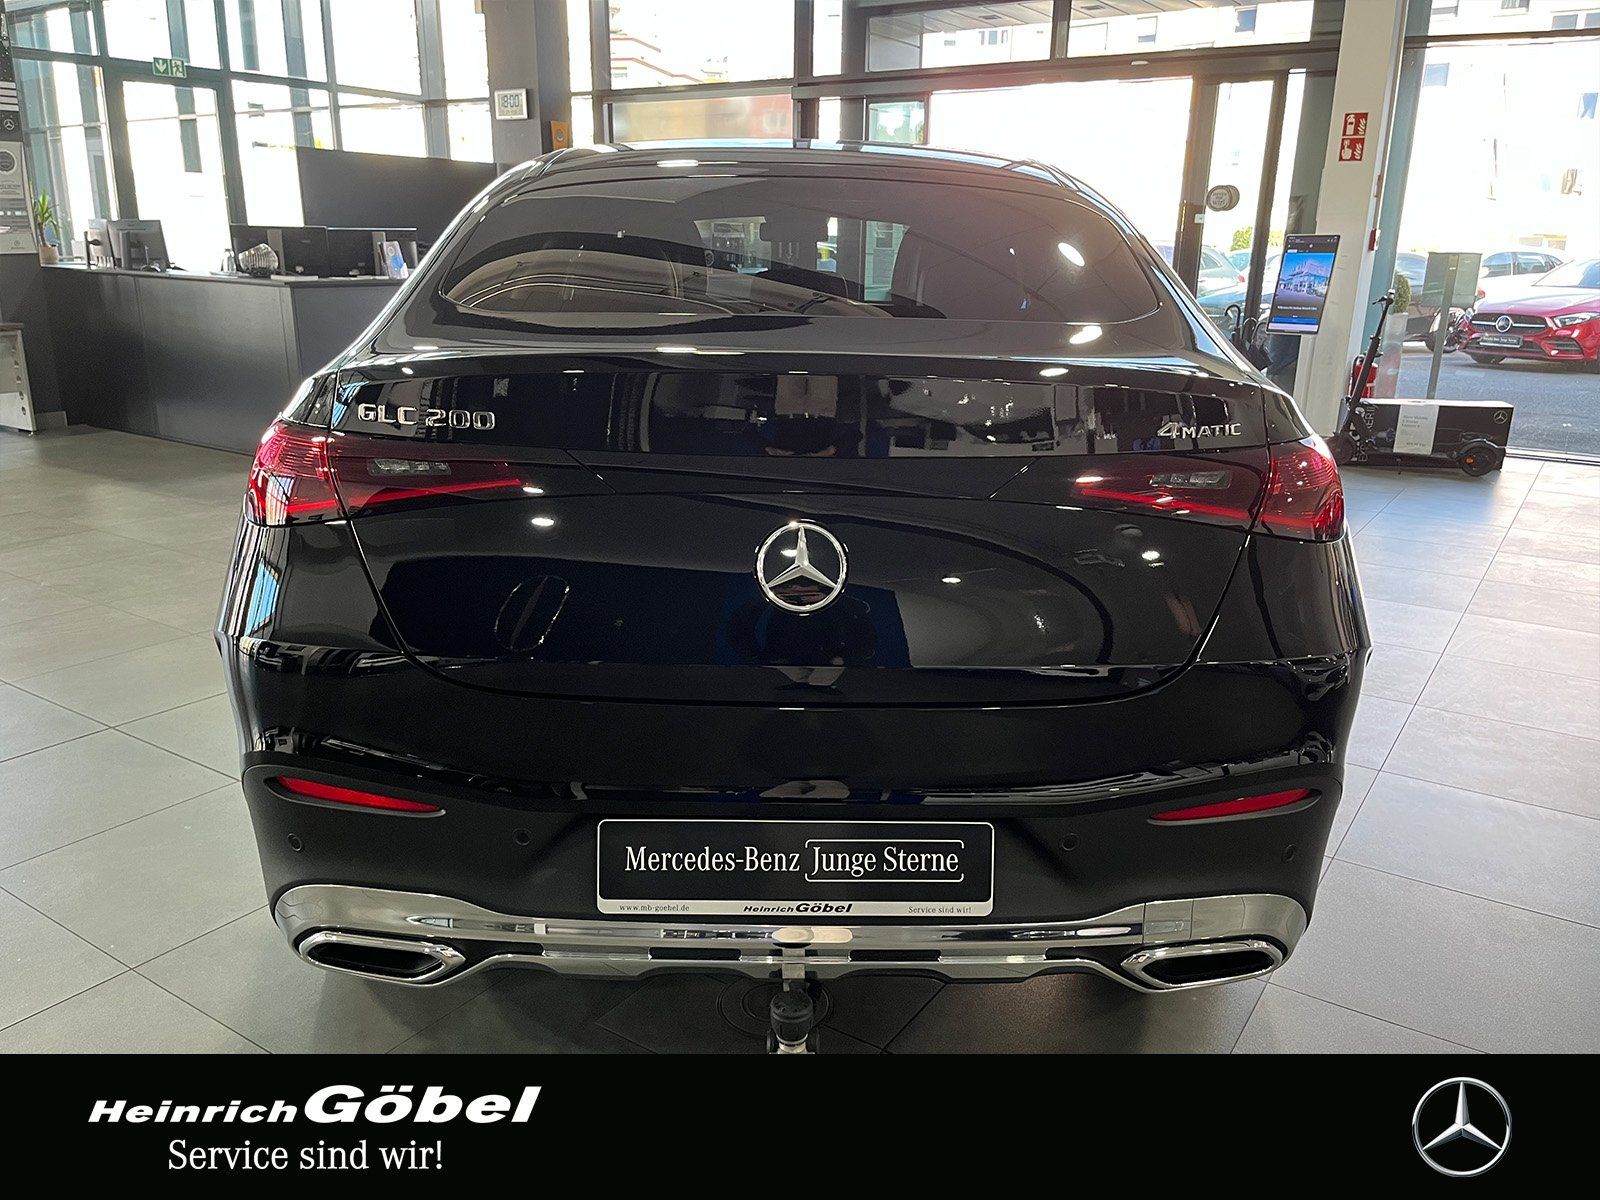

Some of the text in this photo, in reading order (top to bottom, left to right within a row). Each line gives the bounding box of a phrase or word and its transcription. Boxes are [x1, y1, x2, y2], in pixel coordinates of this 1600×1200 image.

[358, 403, 496, 430] GLC 200
[1157, 421, 1242, 439] 4MATIC
[625, 845, 960, 877] Mercedes-Benz Junge Sterne
[619, 904, 690, 912] www.mb-goebel.de
[743, 902, 853, 913] Heinrich Göbel
[908, 906, 937, 914] Service
